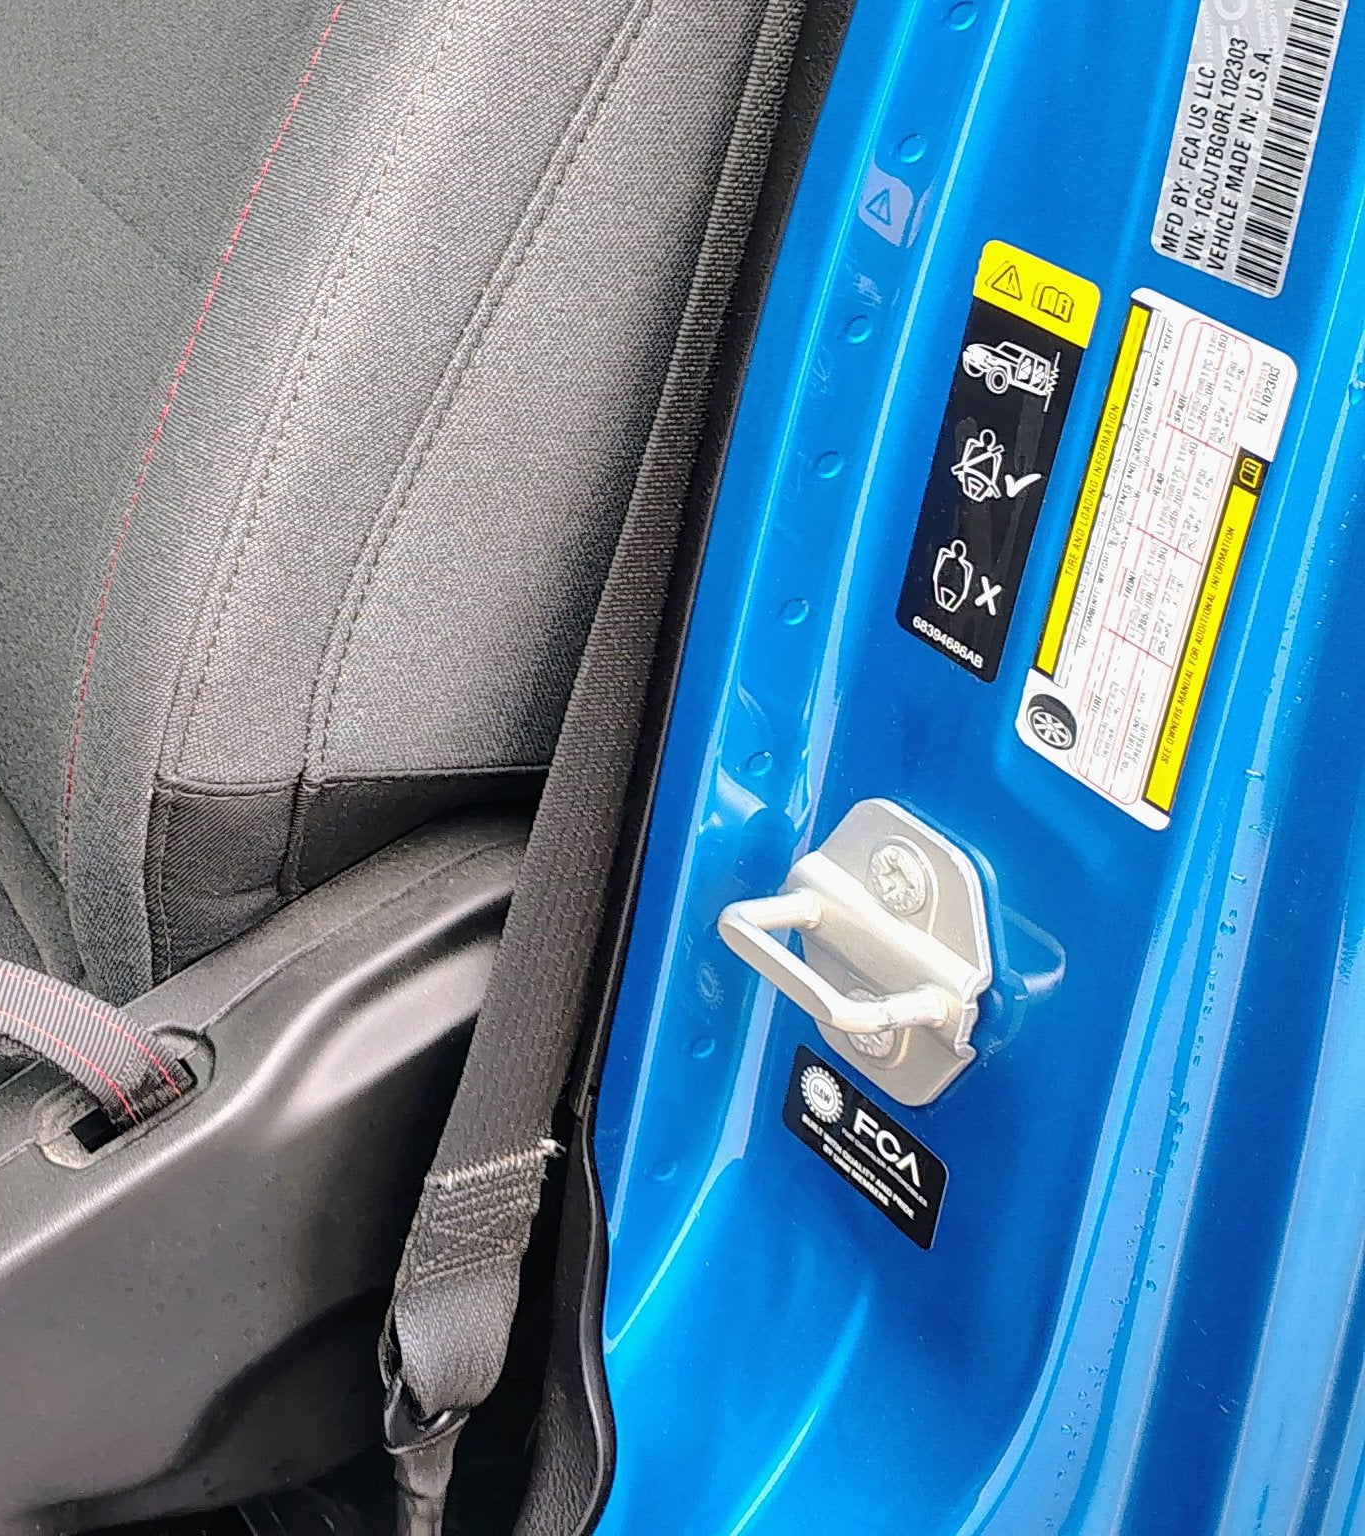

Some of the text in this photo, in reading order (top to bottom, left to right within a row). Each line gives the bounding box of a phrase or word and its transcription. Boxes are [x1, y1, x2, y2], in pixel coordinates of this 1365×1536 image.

[1245, 47, 1273, 102] U.S.A.
[1184, 37, 1248, 263] VIN: 1C6JJTBG0RL102303
[1237, 107, 1259, 134] IN:
[1161, 66, 1216, 253] MFD BY: FCA US LLC
[1225, 138, 1251, 194] MADE
[1207, 196, 1238, 271] VEHICLE
[1065, 554, 1079, 576] TIRE
[1072, 527, 1084, 549] AND
[1080, 481, 1098, 526] LOADING
[1094, 404, 1120, 478] INFORMATION
[913, 615, 984, 668] 68394686AB
[1161, 746, 1171, 764] SEE
[1178, 669, 1194, 706] MANUAL
[1188, 646, 1199, 665] FOR
[1195, 592, 1215, 646] ADDITIONAL
[1211, 527, 1235, 590] INFORMATION
[853, 1108, 920, 1187] FCA
